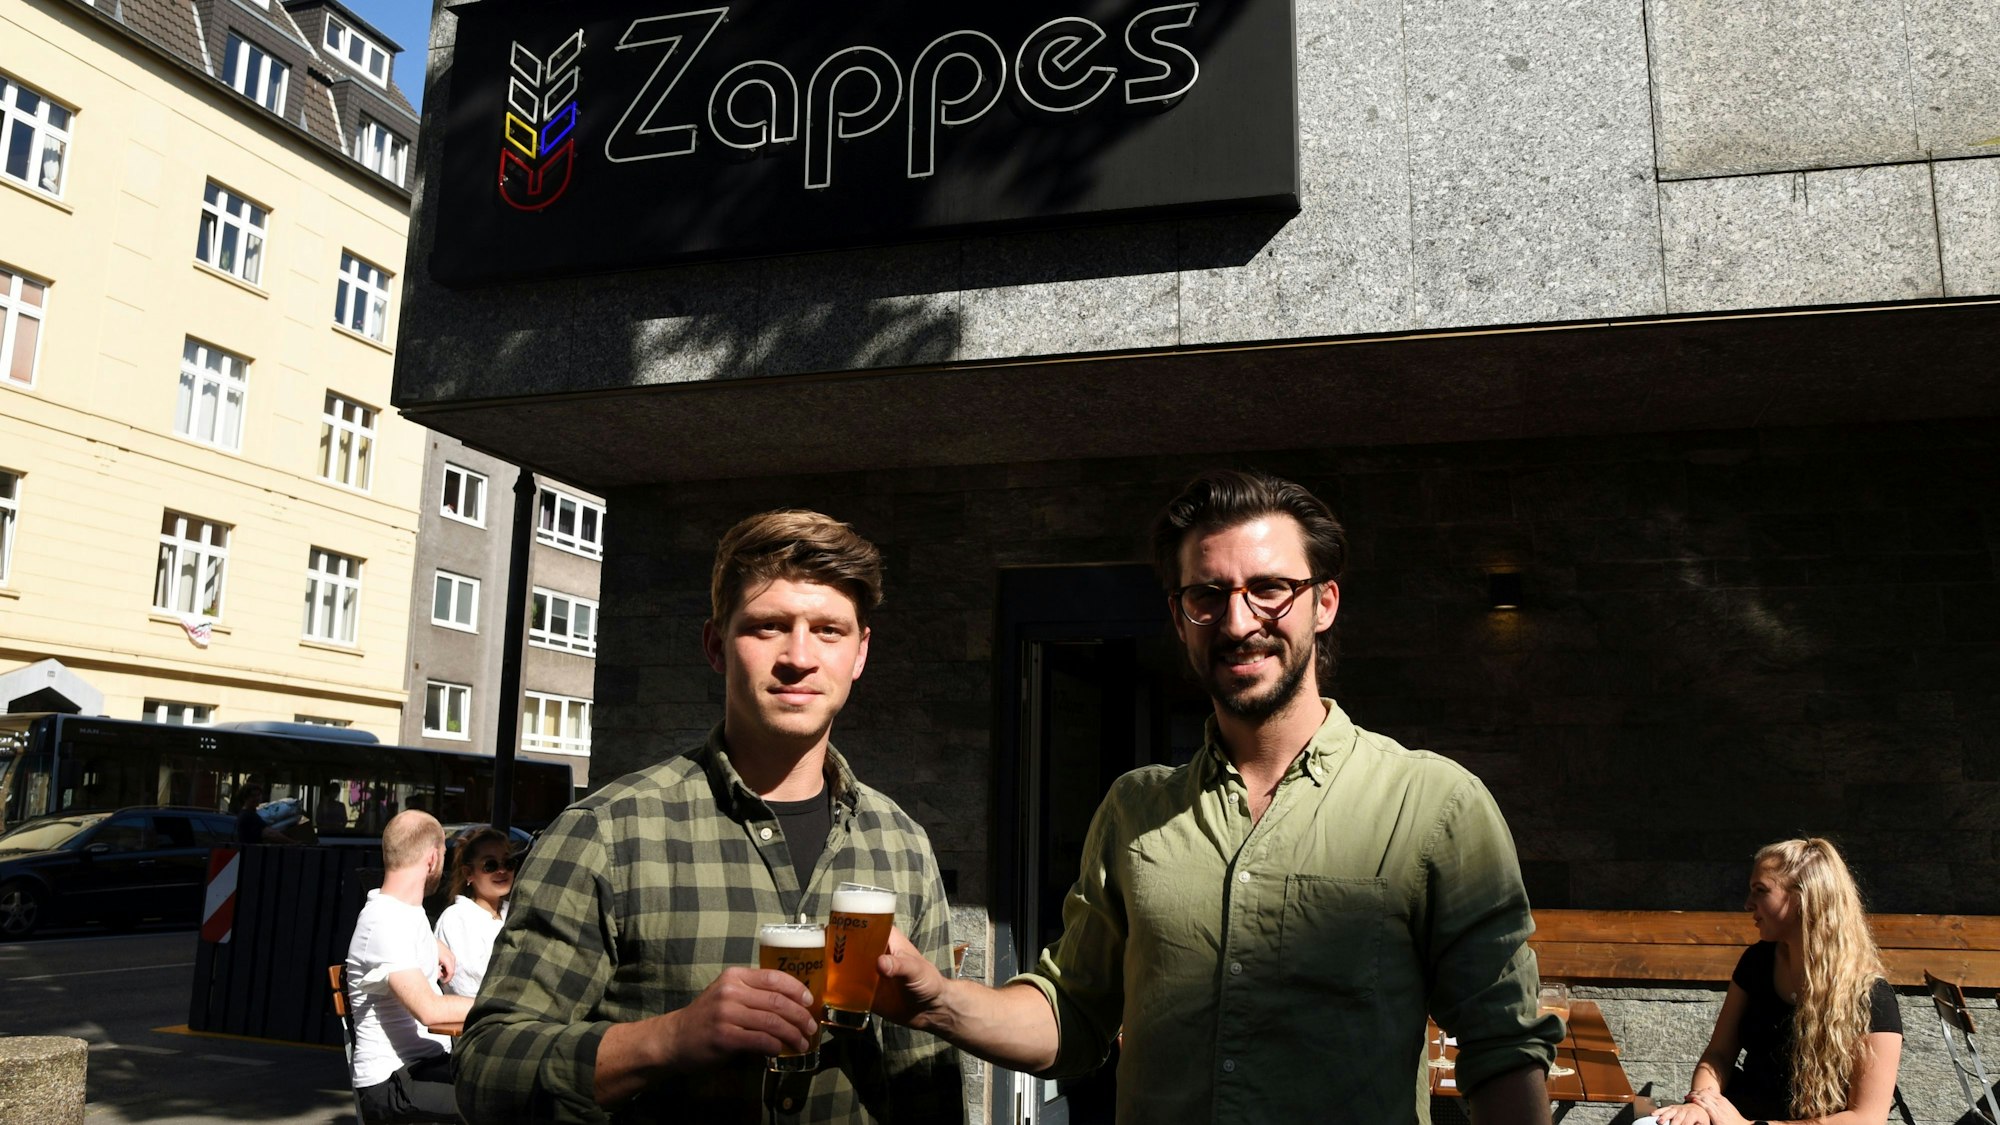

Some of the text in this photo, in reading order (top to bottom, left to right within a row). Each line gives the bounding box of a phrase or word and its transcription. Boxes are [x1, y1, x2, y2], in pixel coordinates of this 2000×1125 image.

[605, 3, 1200, 189] Zappes
[830, 914, 868, 930] appes
[777, 956, 824, 976] Zappes
